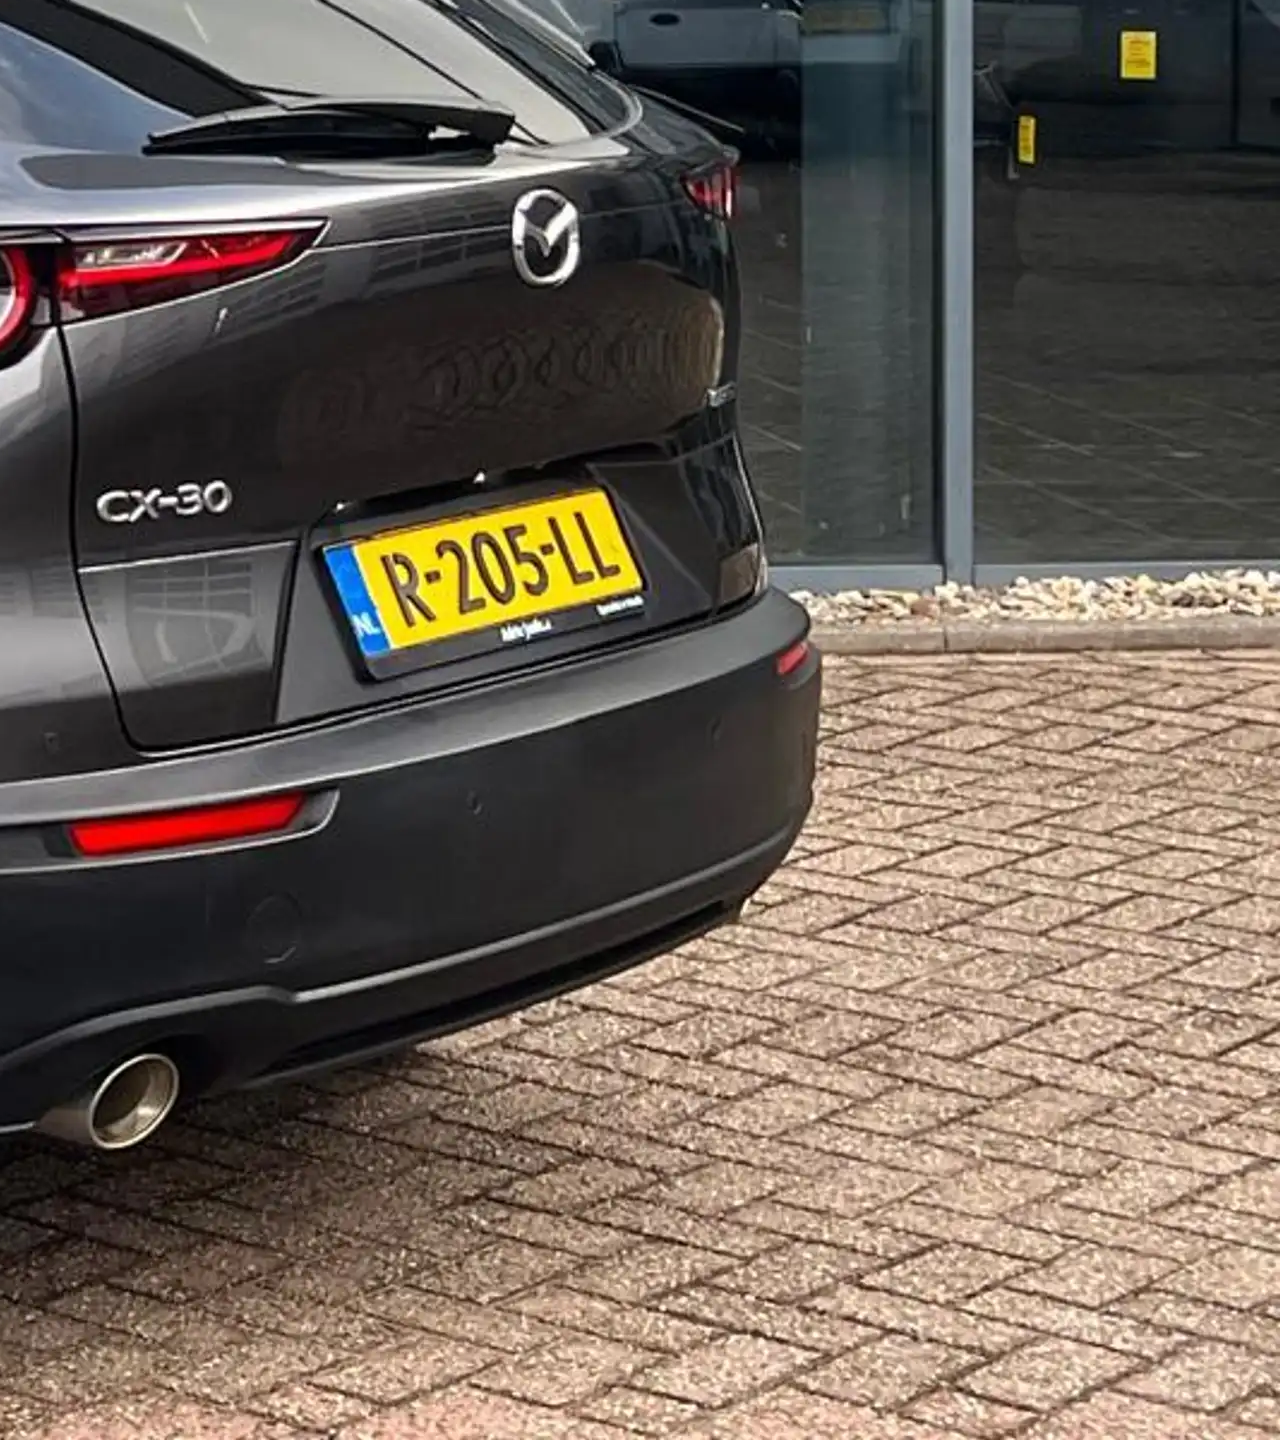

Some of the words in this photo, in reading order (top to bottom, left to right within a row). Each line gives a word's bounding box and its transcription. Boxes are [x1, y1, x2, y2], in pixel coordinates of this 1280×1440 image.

[96, 479, 233, 523] CX-30
[380, 511, 621, 628] R-205-LL
[351, 612, 379, 637] NL
